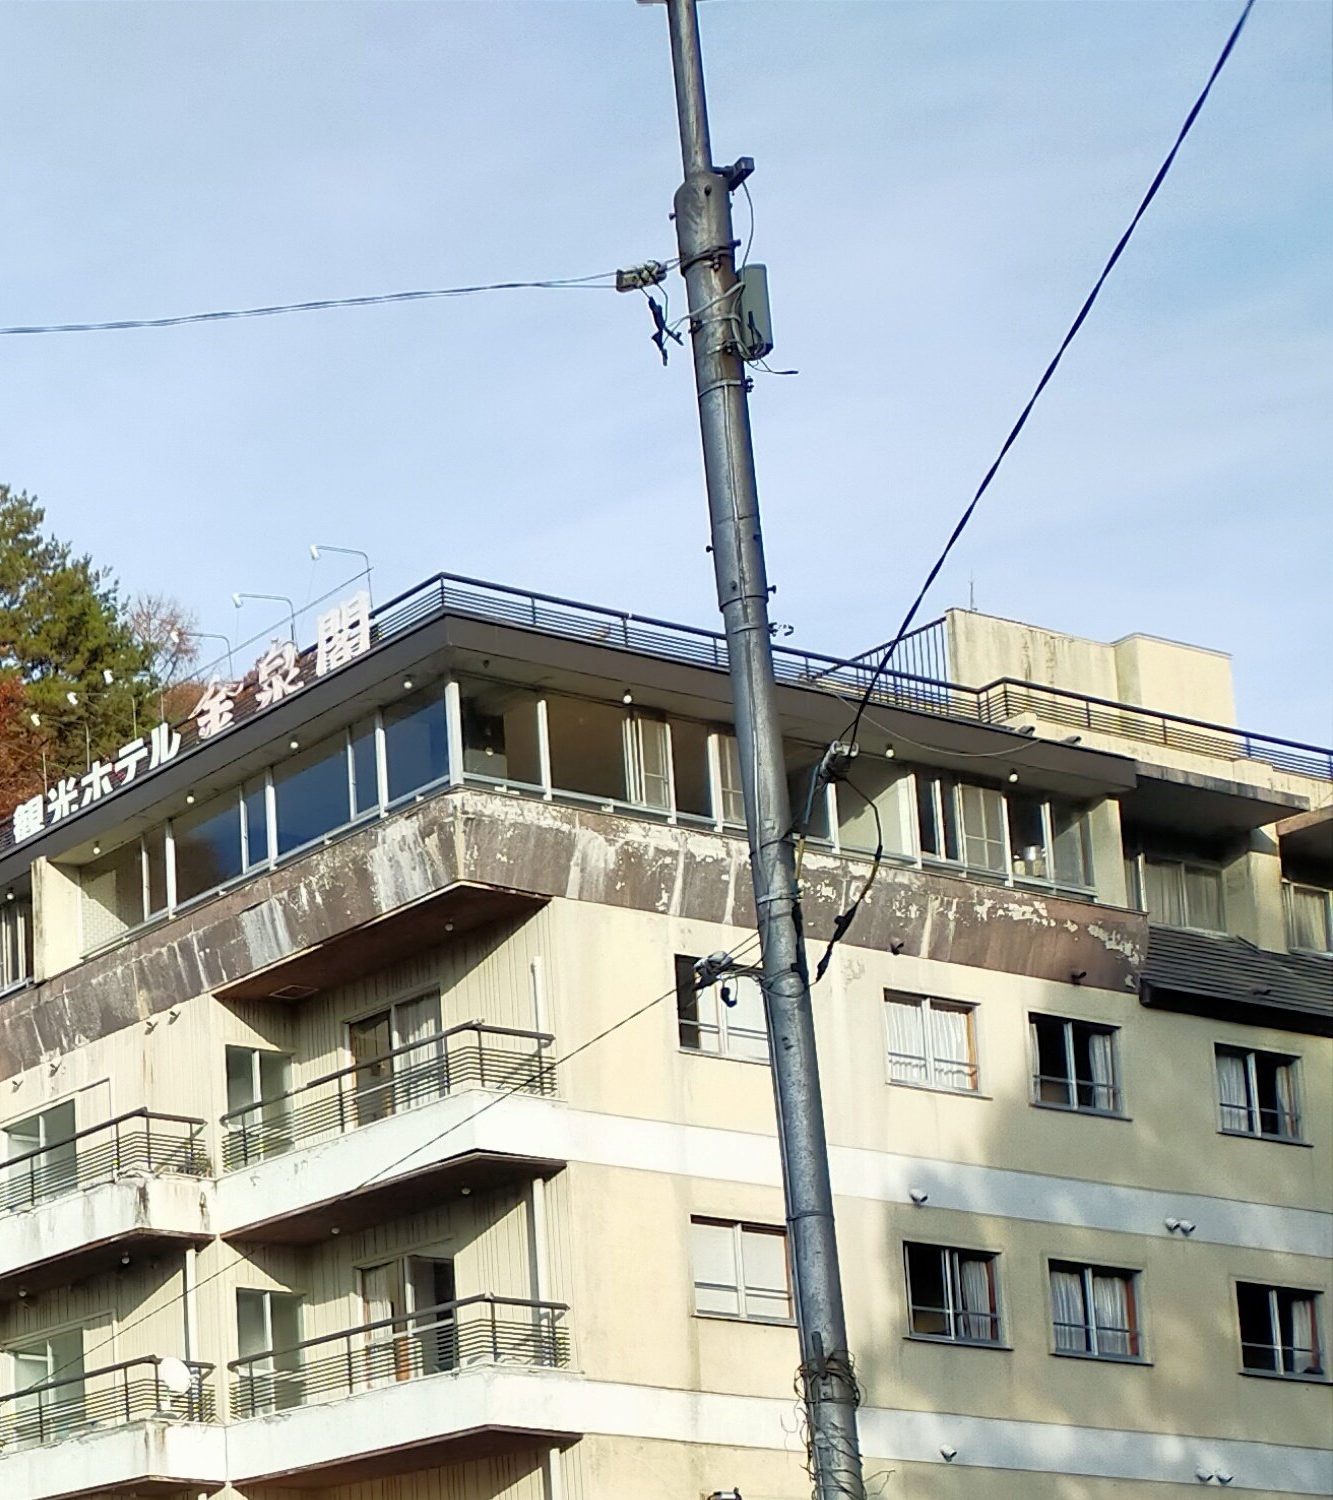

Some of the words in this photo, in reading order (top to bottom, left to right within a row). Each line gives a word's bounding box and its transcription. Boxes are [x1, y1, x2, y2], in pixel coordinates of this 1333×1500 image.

[13, 722, 181, 844] 観光ホテル
[187, 590, 371, 740] 金泉閣
